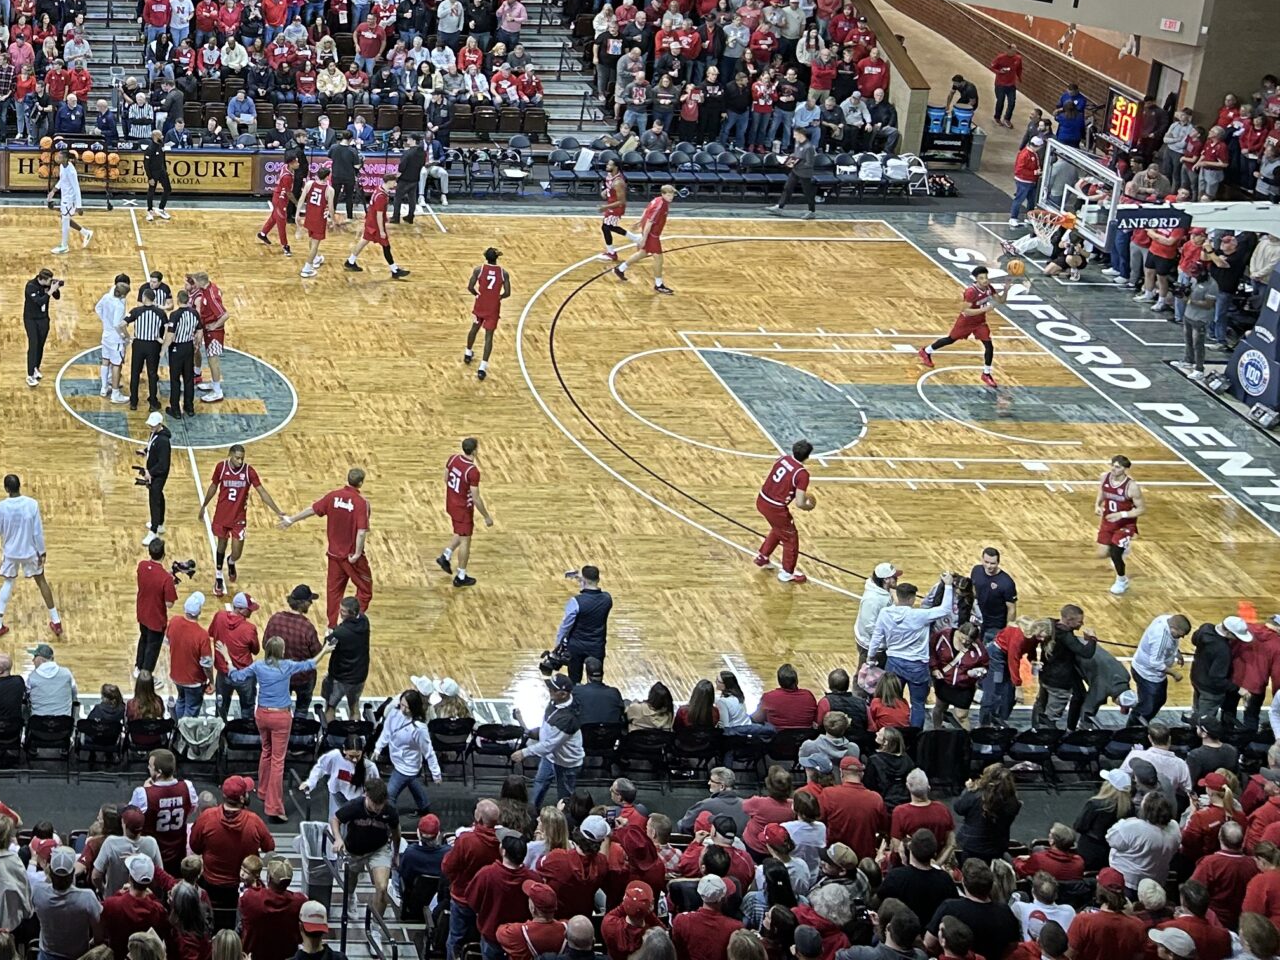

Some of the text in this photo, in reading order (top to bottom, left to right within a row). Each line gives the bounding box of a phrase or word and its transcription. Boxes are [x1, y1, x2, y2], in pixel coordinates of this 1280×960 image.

[176, 5, 185, 15] N
[1109, 109, 1132, 141] 30
[309, 192, 322, 206] 21
[1116, 217, 1180, 229] ANFORD
[486, 275, 496, 290] 7
[772, 466, 787, 483] 9
[447, 471, 461, 494] 31
[227, 488, 237, 501] 2
[1108, 500, 1118, 513] 0
[158, 796, 184, 809] GRIFFIN
[156, 808, 186, 832] 23
